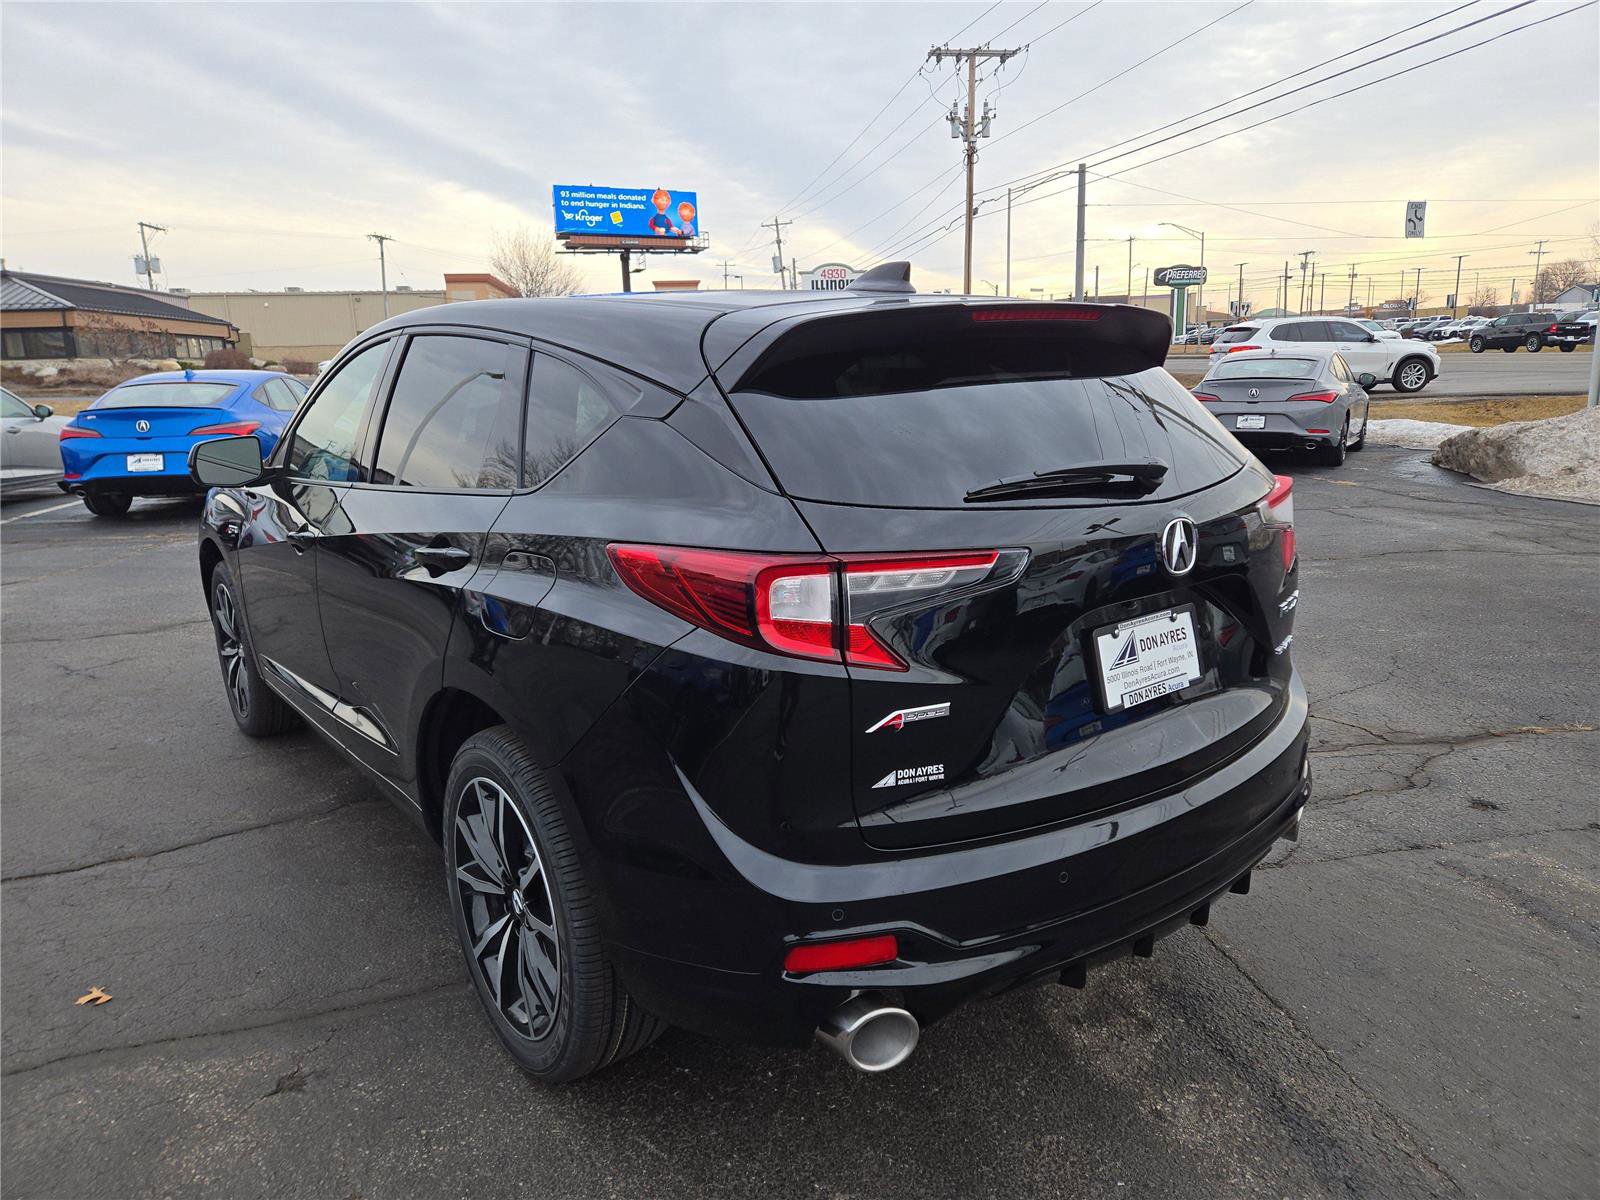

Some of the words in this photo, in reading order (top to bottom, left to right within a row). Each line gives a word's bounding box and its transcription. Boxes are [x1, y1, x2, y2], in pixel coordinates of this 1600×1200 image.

[560, 190, 570, 198] 93
[571, 191, 596, 199] million
[618, 194, 647, 202] donated
[585, 200, 610, 209] hunger
[575, 209, 603, 227] Kroger
[821, 269, 846, 278] 4930
[1140, 635, 1159, 652] DON
[1160, 627, 1187, 646] AYRES
[1107, 674, 1120, 684] 5000
[1122, 669, 1138, 678] Illinois
[1139, 664, 1153, 673] Road
[1157, 659, 1167, 667] Fort
[1124, 667, 1180, 689] DonAyresAcura.com
[1129, 691, 1144, 705] DON
[1144, 683, 1166, 699] AYRES
[1168, 682, 1184, 692] Acura
[897, 768, 916, 779] DON
[916, 764, 944, 776] AYRES
